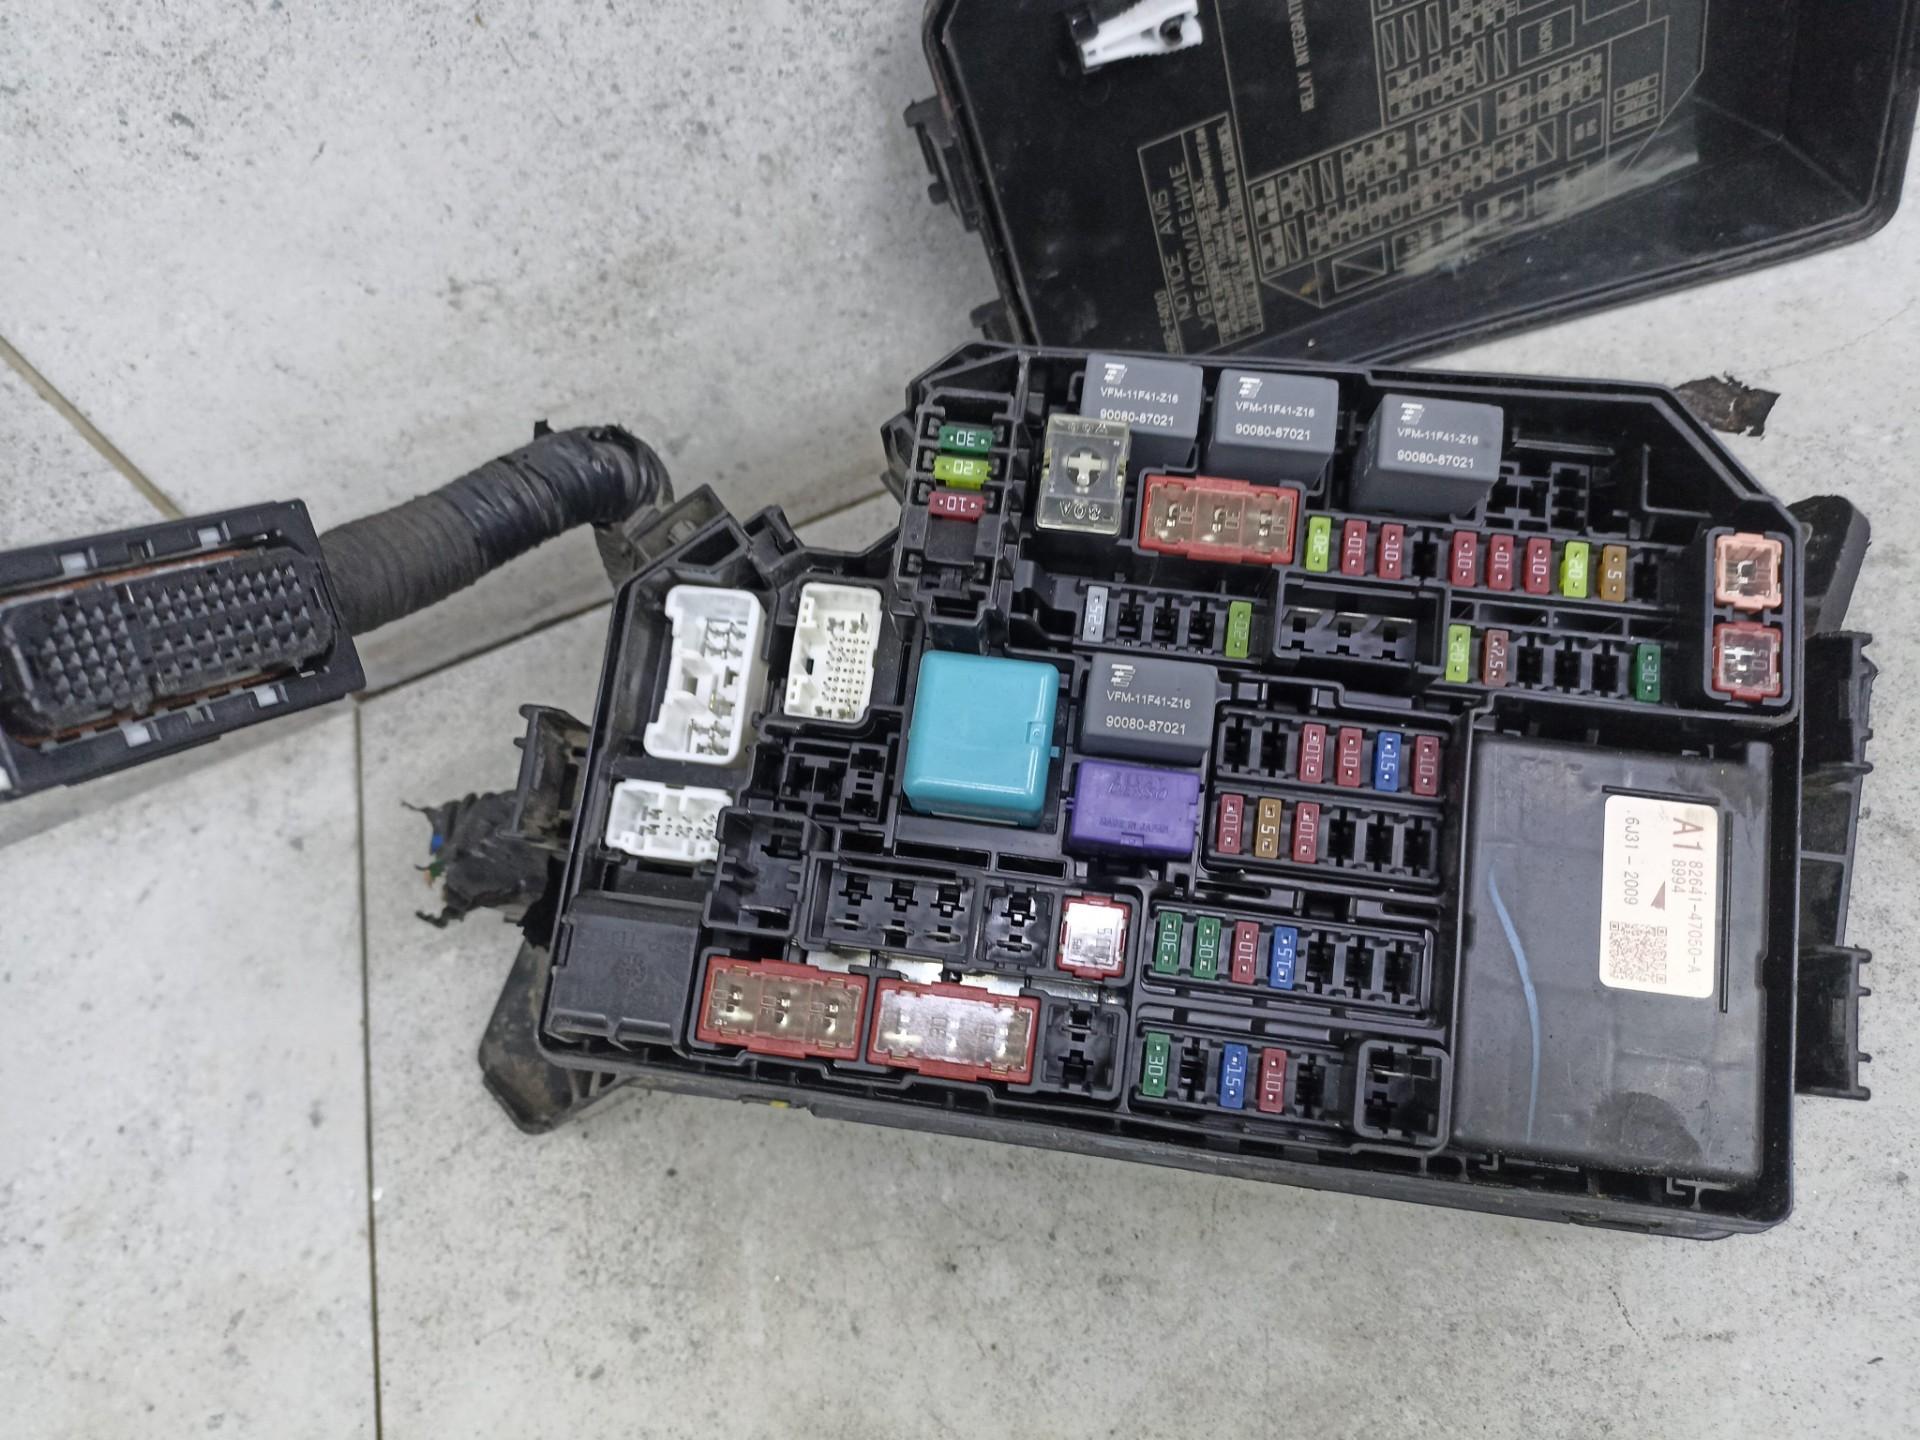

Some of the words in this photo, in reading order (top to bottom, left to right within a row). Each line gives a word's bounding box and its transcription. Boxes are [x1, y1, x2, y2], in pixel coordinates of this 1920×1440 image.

[1152, 189, 1176, 235] AVIS
[1168, 160, 1216, 331] УВЕДОМЛЕНИЕ
[1165, 250, 1192, 322] NOTICE
[1100, 386, 1179, 404] VFM-11F41-Z16
[1100, 408, 1175, 427] 90080-87021
[1235, 400, 1316, 418] VFM-11F41-Z16
[956, 430, 977, 448] 30
[1235, 423, 1312, 441] 90080-87021
[1397, 427, 1479, 446] VFM-11F41-Z16
[953, 459, 974, 476] 20
[1397, 449, 1475, 469] 90080-87021
[946, 495, 967, 513] 10
[1313, 534, 1329, 555] 20
[1347, 537, 1363, 557] 10
[1384, 541, 1399, 561] 10
[1457, 550, 1473, 569] 10
[1494, 551, 1510, 571] 10
[1531, 555, 1547, 576] 10
[1567, 558, 1584, 579] 20
[1607, 569, 1622, 580] 5
[1087, 603, 1105, 625] 25
[1232, 621, 1249, 641] 20
[1450, 640, 1465, 663] 20
[1489, 648, 1505, 669] 7.5
[1751, 649, 1769, 671] 50
[1641, 664, 1658, 683] 30
[1106, 689, 1192, 710] VFM-11F41-Z16
[1105, 715, 1186, 736] 90080-87021
[1305, 743, 1321, 763] 10
[1343, 748, 1359, 768] 10
[1381, 751, 1397, 772] 15
[1420, 756, 1436, 776] 10
[1223, 814, 1239, 834] 10
[1261, 823, 1276, 835] 5
[1299, 821, 1315, 843] 10
[1625, 817, 1640, 850] 6J31
[1672, 817, 1705, 851] A1
[1671, 859, 1687, 894] 8994
[1623, 871, 1639, 906] 2009
[1687, 860, 1704, 975] 82641-47050-A
[1161, 931, 1178, 953] 30
[1198, 938, 1215, 959] 30
[1238, 942, 1254, 963] 10
[1276, 947, 1293, 969] 15
[1147, 1054, 1164, 1077] 30
[1225, 1063, 1242, 1087] 15
[1265, 1071, 1282, 1093] 10
